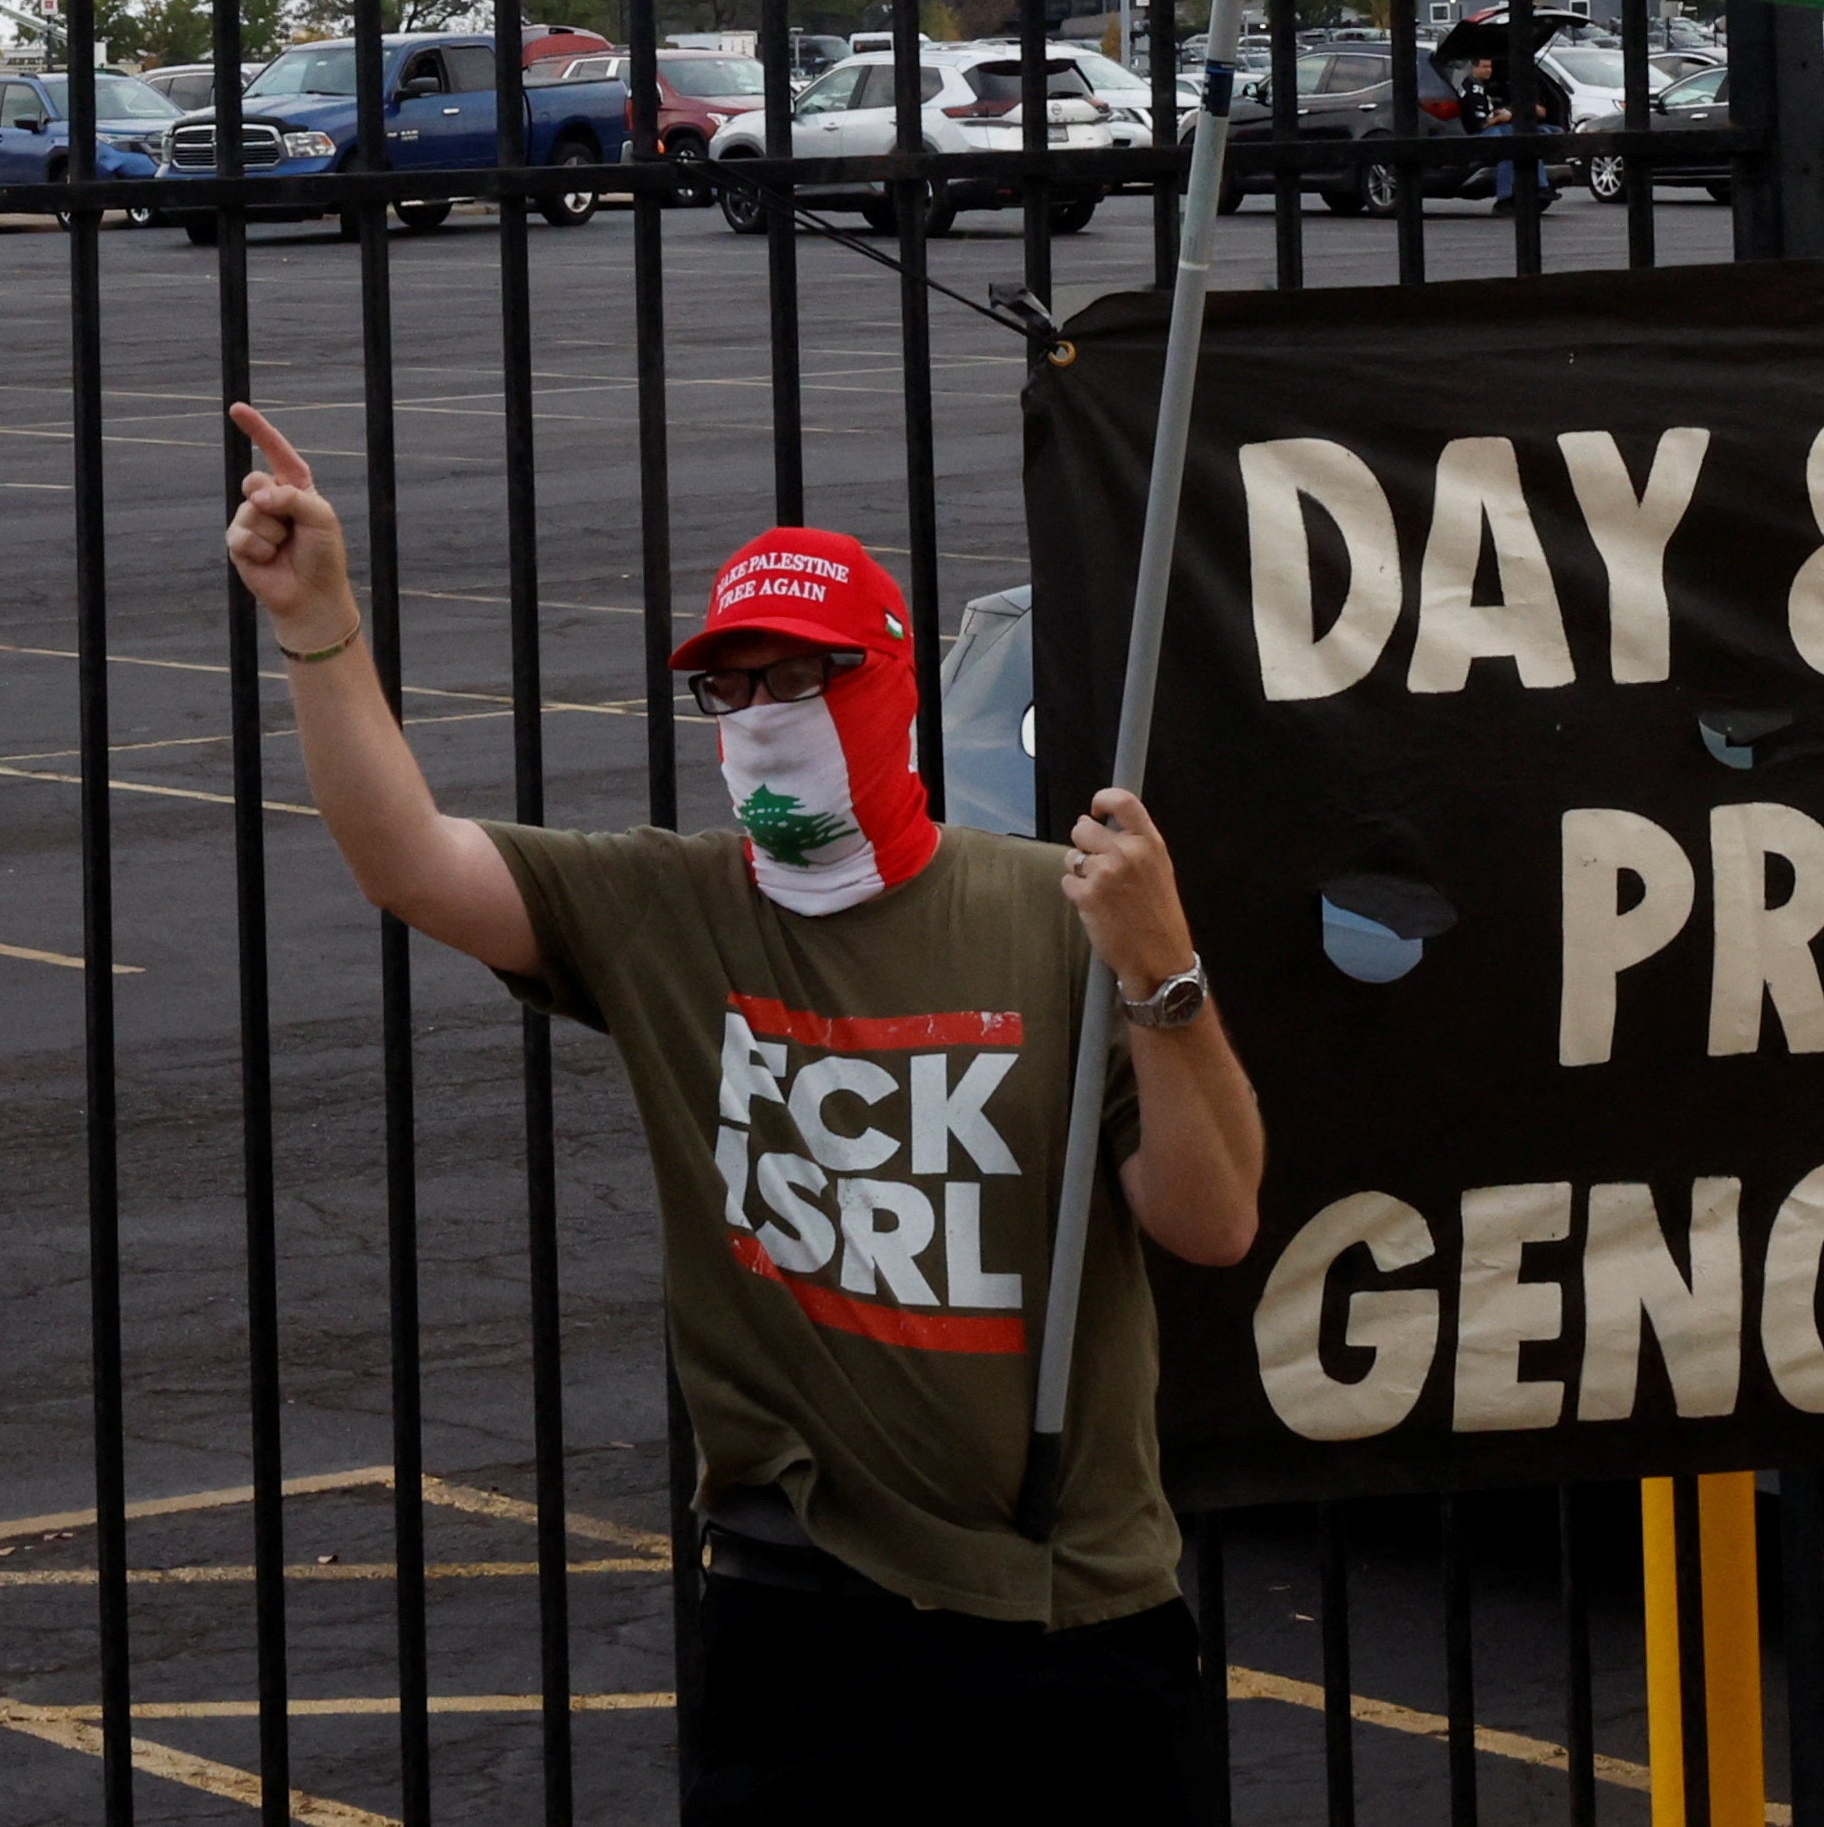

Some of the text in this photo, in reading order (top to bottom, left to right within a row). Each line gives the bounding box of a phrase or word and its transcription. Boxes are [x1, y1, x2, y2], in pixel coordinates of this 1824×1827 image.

[716, 551, 850, 601] MAKE PALESTINE
[717, 577, 827, 615] FREE AGAIN
[1238, 427, 1710, 702] DAY
[718, 1011, 1023, 1174] FCK
[714, 1124, 1023, 1309] ISRL
